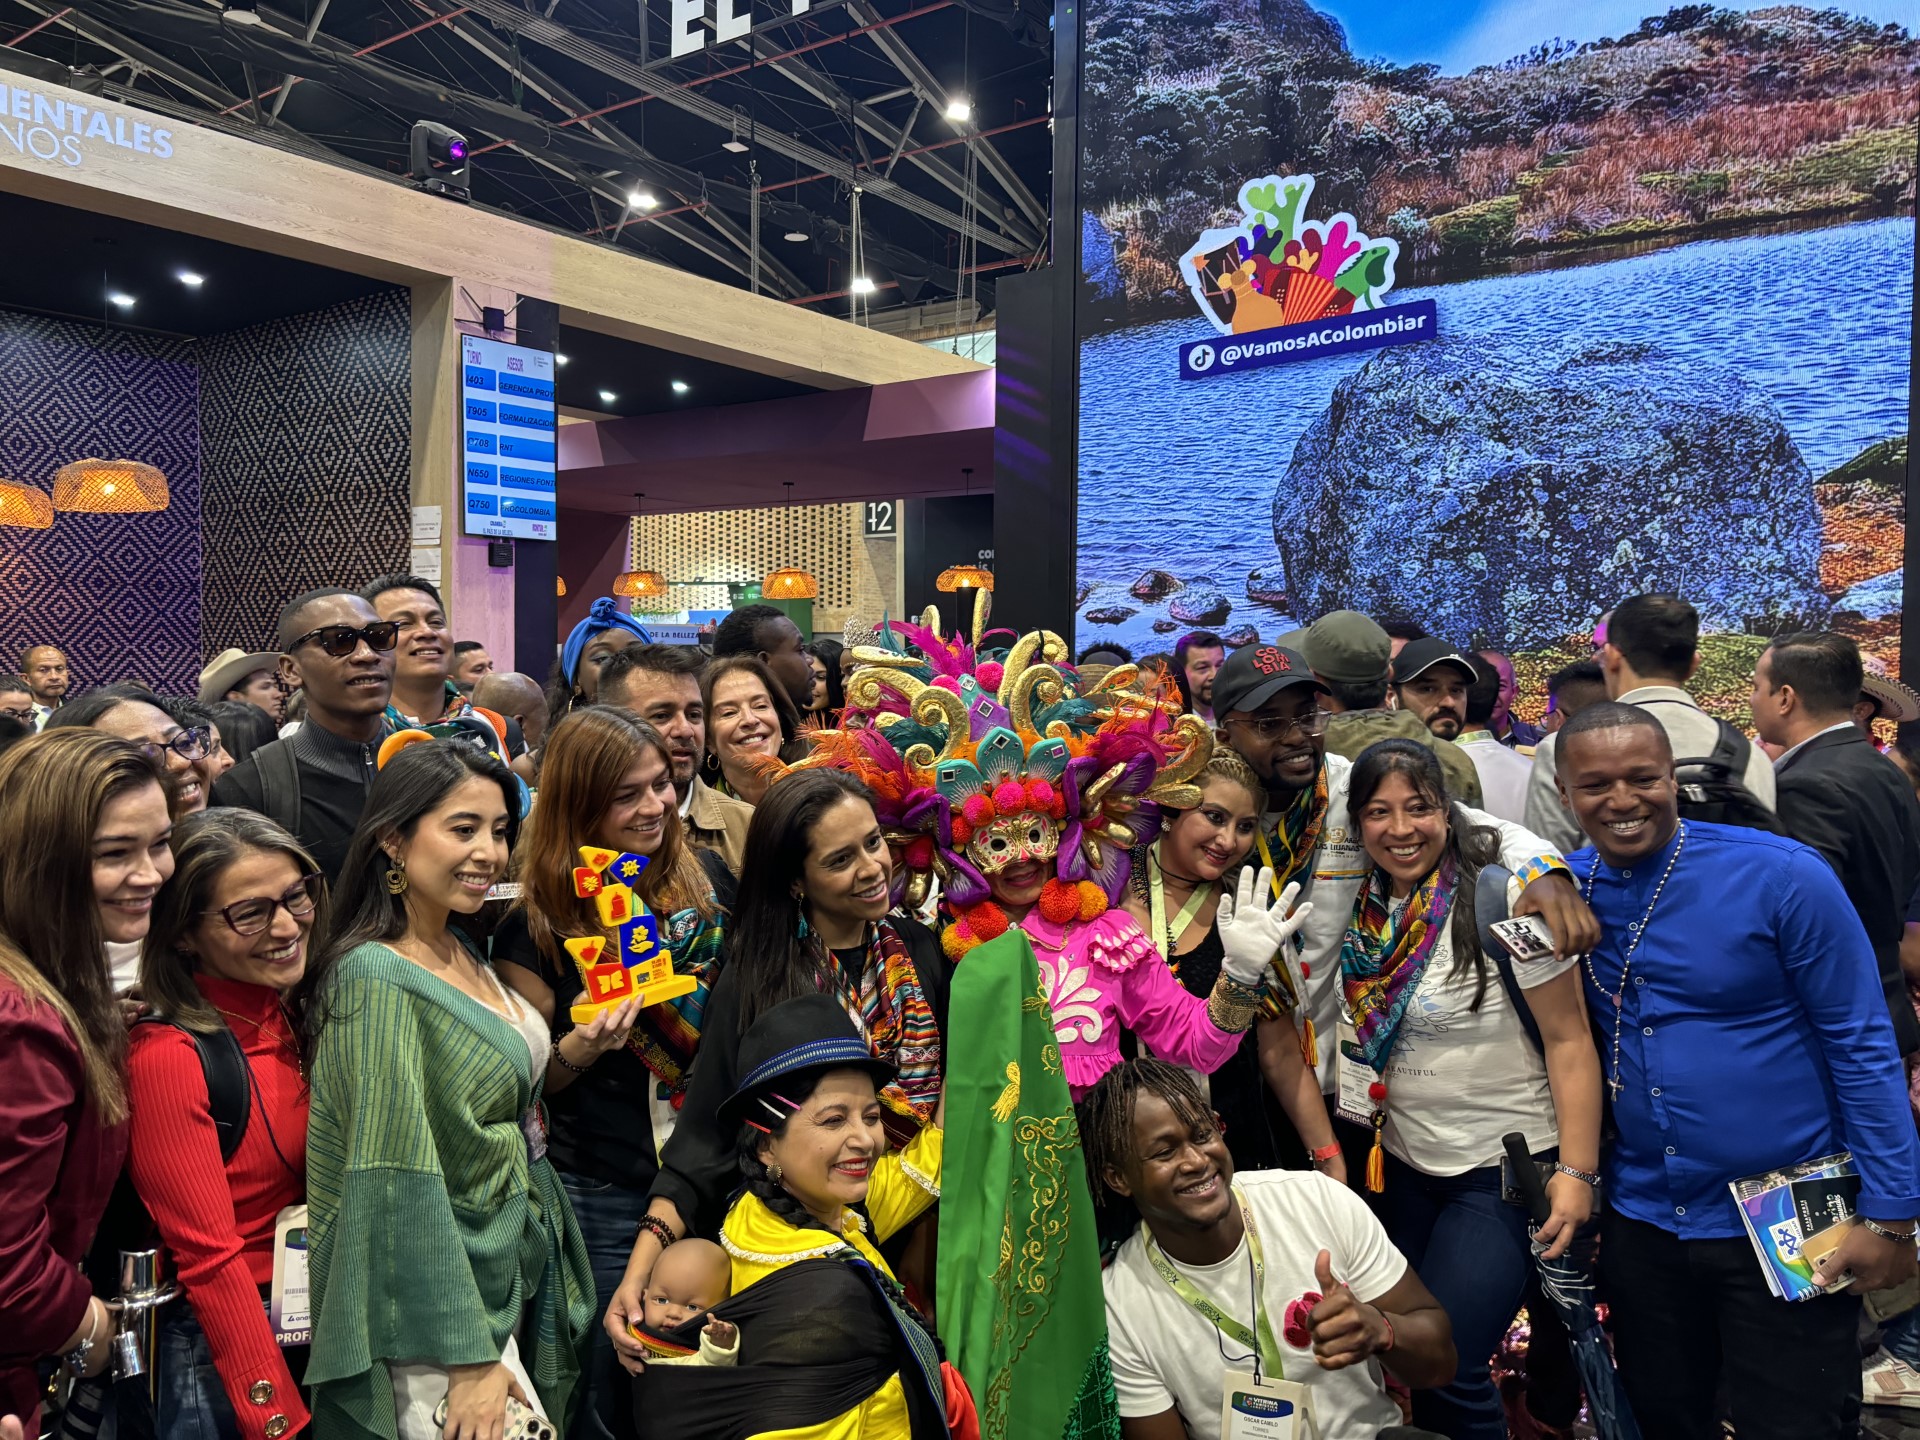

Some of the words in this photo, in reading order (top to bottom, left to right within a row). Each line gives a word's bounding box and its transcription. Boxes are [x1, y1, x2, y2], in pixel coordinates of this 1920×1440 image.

[1220, 313, 1427, 366] @VamosAColombiar
[507, 356, 524, 372] ASESOR
[500, 382, 534, 394] GERENCIA
[467, 406, 487, 417] T905
[500, 412, 555, 427] FORMALIZACION
[500, 443, 513, 452] RNT
[468, 468, 489, 479] N650
[500, 473, 536, 485] REGIONES
[468, 499, 490, 509] Q750
[501, 505, 551, 516] PROCOLOMBIA
[868, 502, 892, 532] 12
